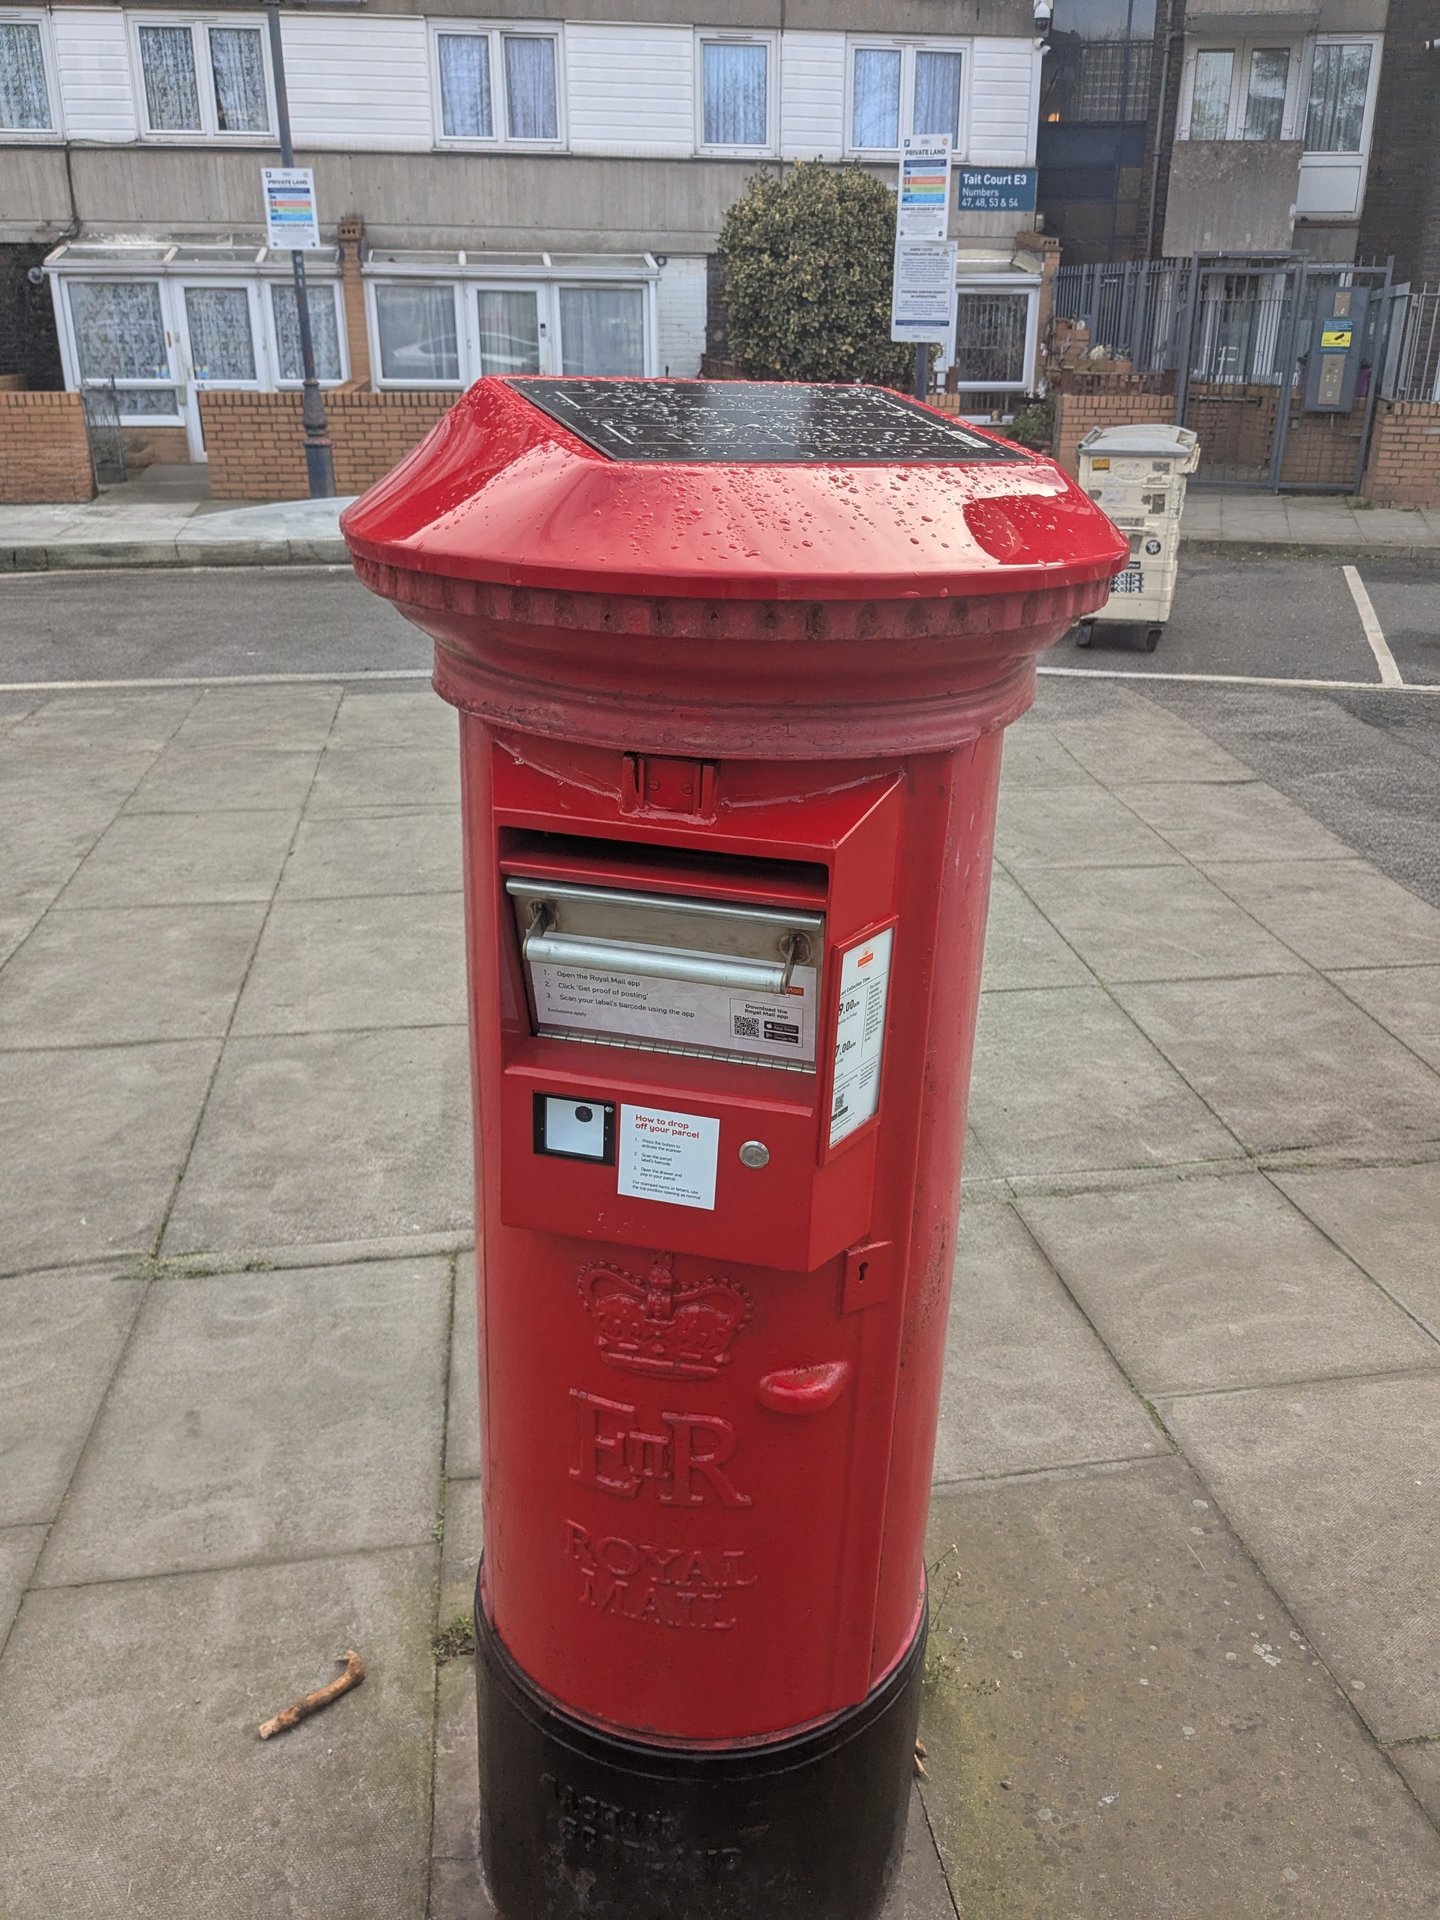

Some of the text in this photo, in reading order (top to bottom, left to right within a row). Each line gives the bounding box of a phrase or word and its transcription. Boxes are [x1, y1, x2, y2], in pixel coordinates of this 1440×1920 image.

[963, 173, 1027, 185] Tait Court E3
[962, 188, 1000, 197] Numbers
[962, 198, 1018, 208] 47, 48, 53 & 54
[556, 970, 576, 980] Open
[590, 974, 610, 984] Royal
[558, 982, 576, 990] Click
[592, 986, 611, 996] proof
[846, 981, 862, 993] Collection
[560, 994, 577, 1002] Scan
[596, 998, 618, 1007] label's
[619, 1002, 646, 1011] barcode
[648, 1005, 668, 1016] using
[669, 1008, 680, 1016] the
[682, 1010, 695, 1018] app
[744, 1008, 762, 1016] Royal
[745, 1004, 776, 1012] Download
[635, 1114, 654, 1124] How
[668, 1120, 689, 1130] drop
[650, 1124, 670, 1134] your
[672, 1129, 700, 1138] parcel
[564, 1518, 758, 1588] ROYAL
[578, 1567, 737, 1630] MAIL
